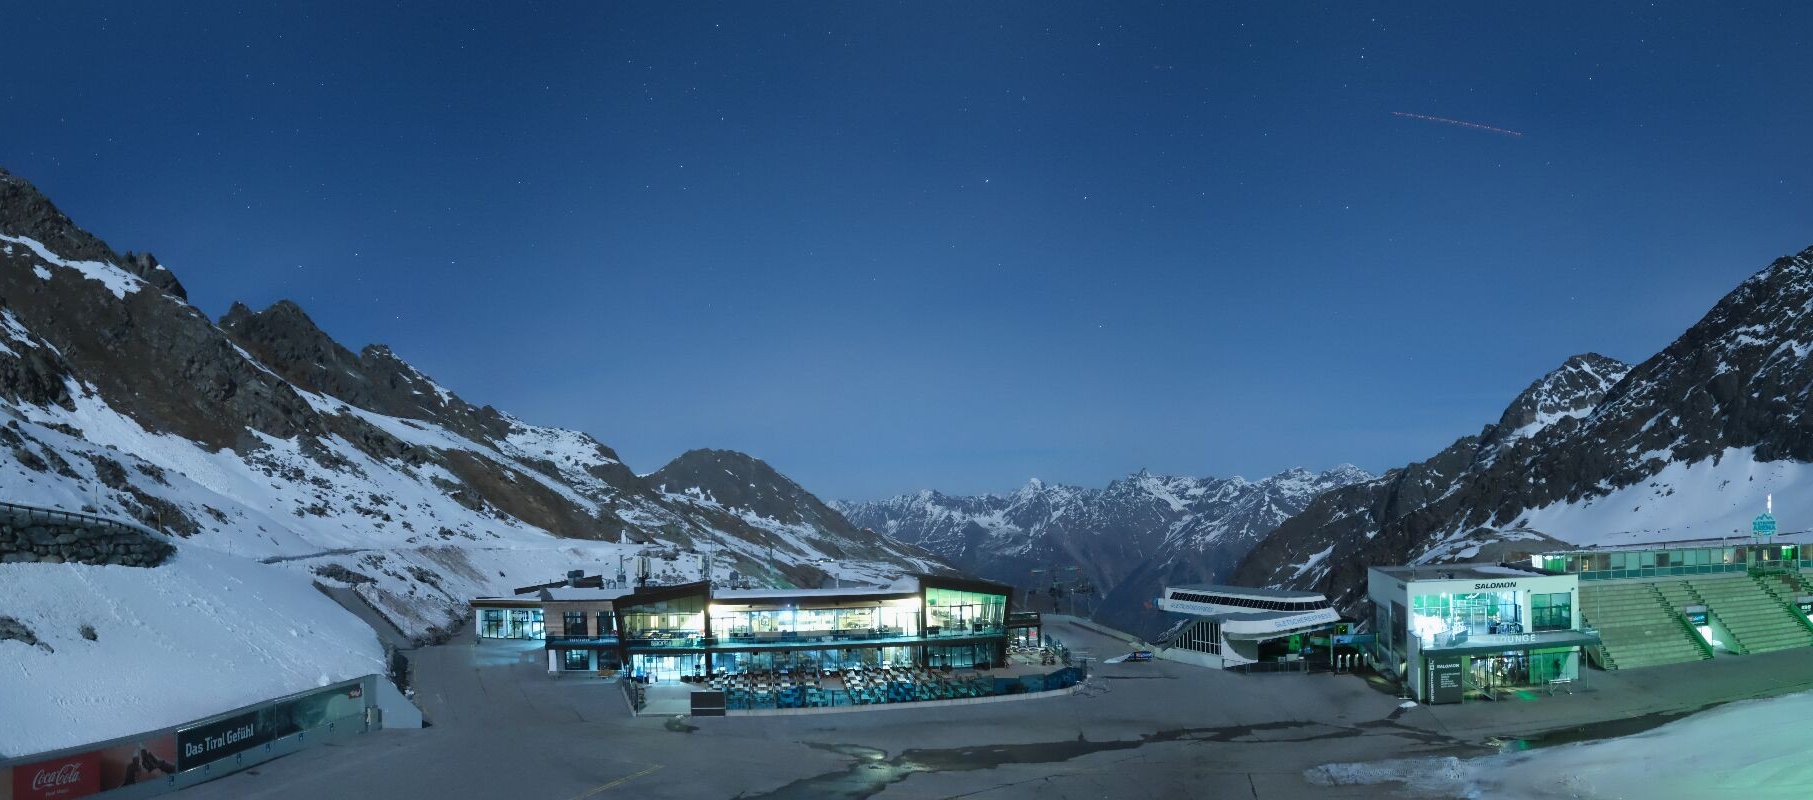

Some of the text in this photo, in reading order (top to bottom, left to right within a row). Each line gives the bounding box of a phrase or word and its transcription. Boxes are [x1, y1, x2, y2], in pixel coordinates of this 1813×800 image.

[1474, 581, 1517, 590] SALOMON
[185, 723, 254, 758] Das Tirol Gefühl
